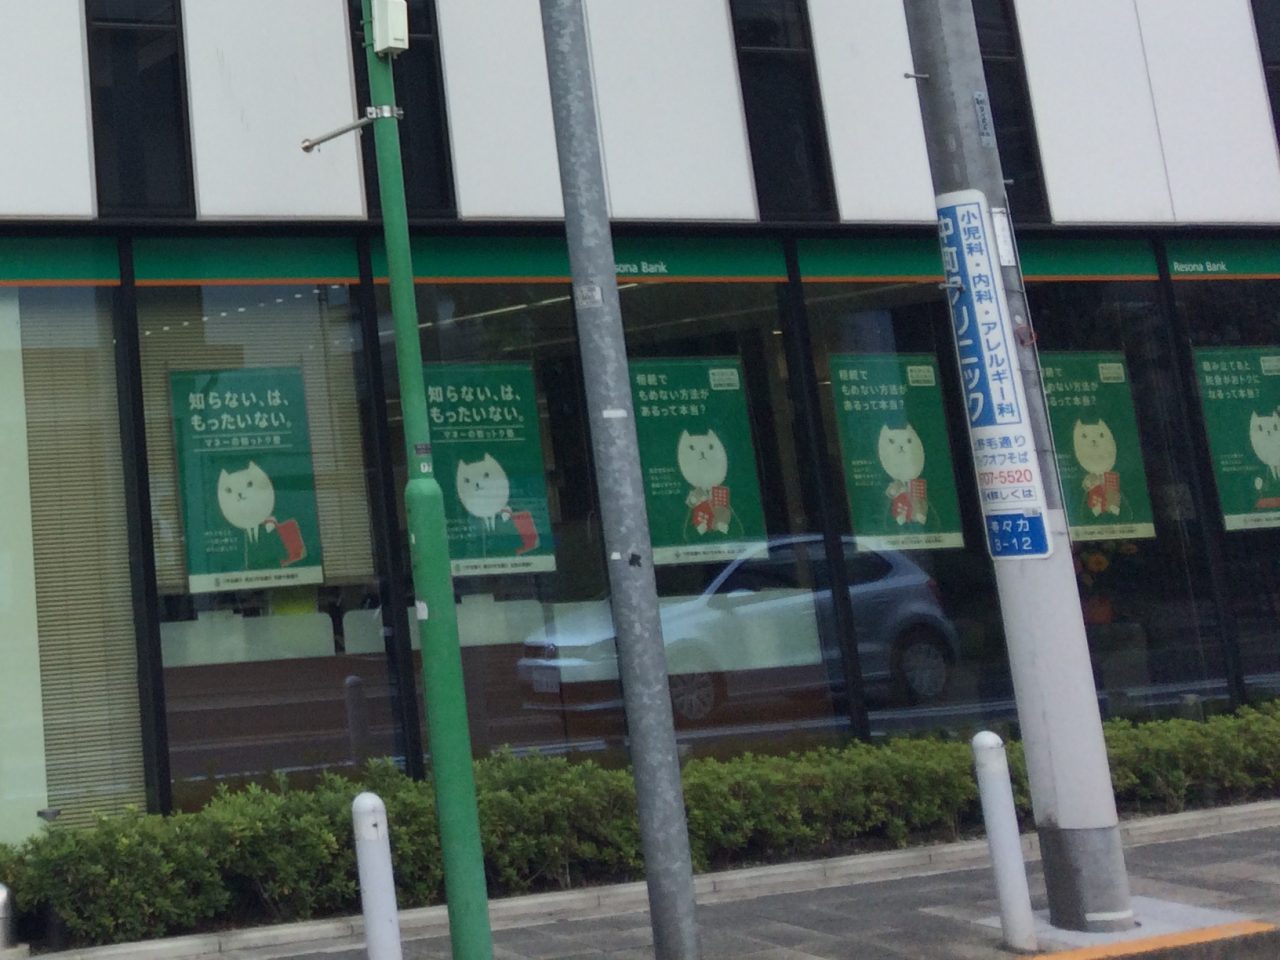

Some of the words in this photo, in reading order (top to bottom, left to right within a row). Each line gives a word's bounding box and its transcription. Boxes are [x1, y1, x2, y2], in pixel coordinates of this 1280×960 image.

[615, 263, 639, 273] sona
[641, 261, 669, 273] Bank
[1173, 261, 1204, 272] Resona
[1205, 260, 1228, 272] Bank
[961, 210, 1016, 417] 小児科・内科・アレルギー科
[190, 411, 292, 431] もったいない。
[430, 406, 524, 423] もったいない。
